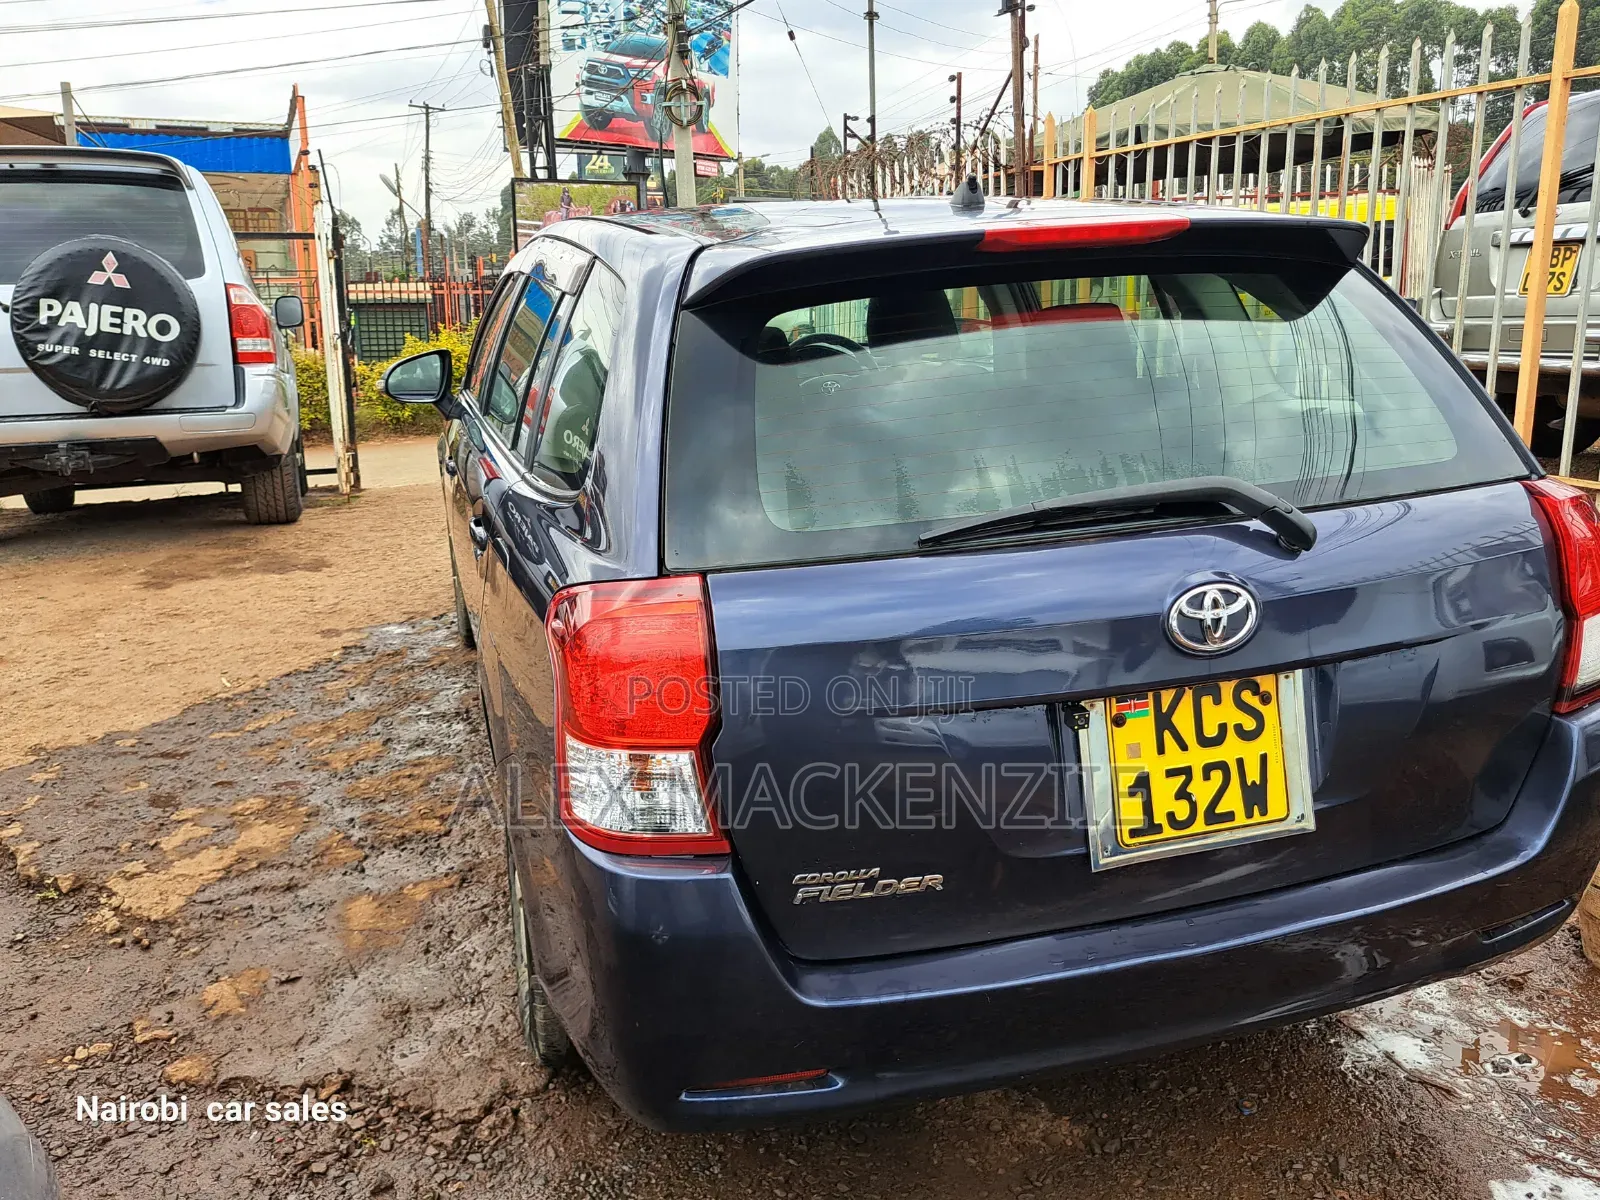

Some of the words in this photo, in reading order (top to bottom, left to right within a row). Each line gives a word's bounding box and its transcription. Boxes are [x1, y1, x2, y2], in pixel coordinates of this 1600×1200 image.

[1448, 248, 1482, 259] X-TIL
[1549, 247, 1573, 269] BP
[38, 298, 181, 342] PAJERO
[37, 343, 80, 355] SUPER
[89, 348, 138, 363] SELECT
[143, 355, 171, 367] 4WD
[1152, 678, 1266, 756] KCS
[1127, 752, 1269, 839] 132W
[792, 867, 881, 885] COROLLA
[792, 874, 944, 905] FIELDER
